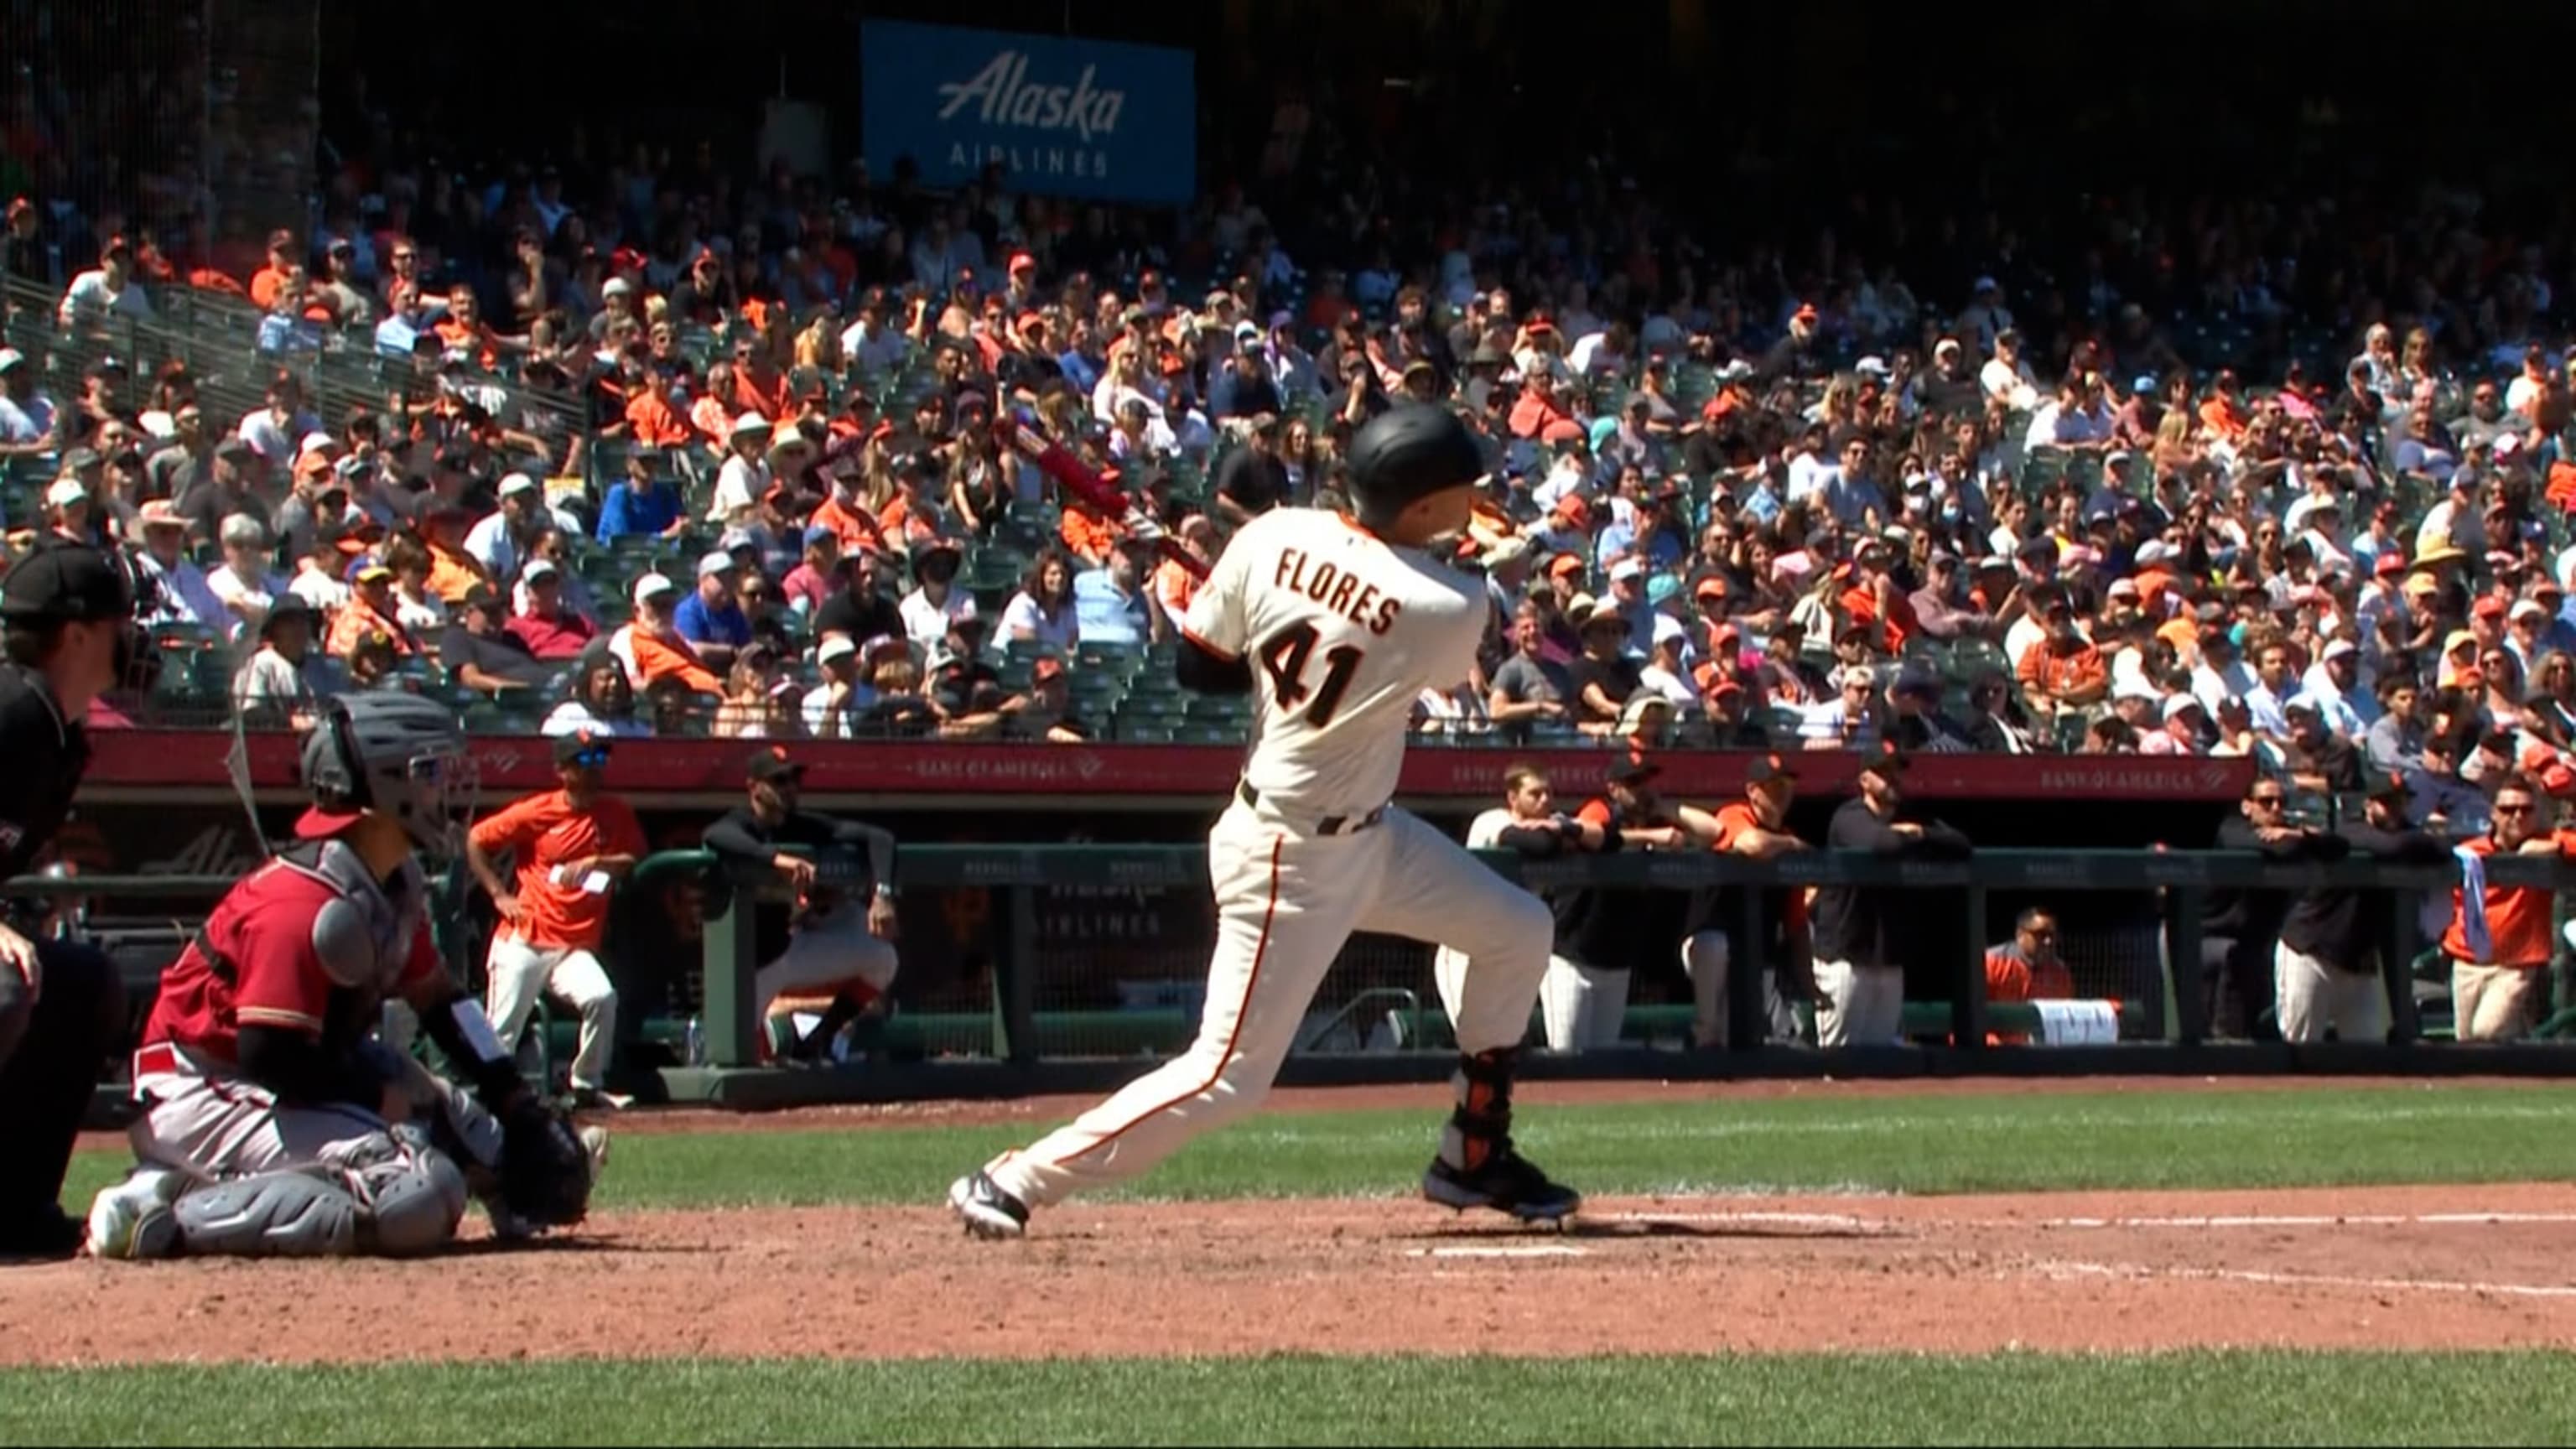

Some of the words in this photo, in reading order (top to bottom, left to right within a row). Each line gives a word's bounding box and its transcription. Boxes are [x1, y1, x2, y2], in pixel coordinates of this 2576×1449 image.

[937, 50, 1124, 143] Alaska
[949, 143, 1107, 178] AIRLINES
[1275, 548, 1401, 636] FLORES
[1260, 618, 1363, 729] 41
